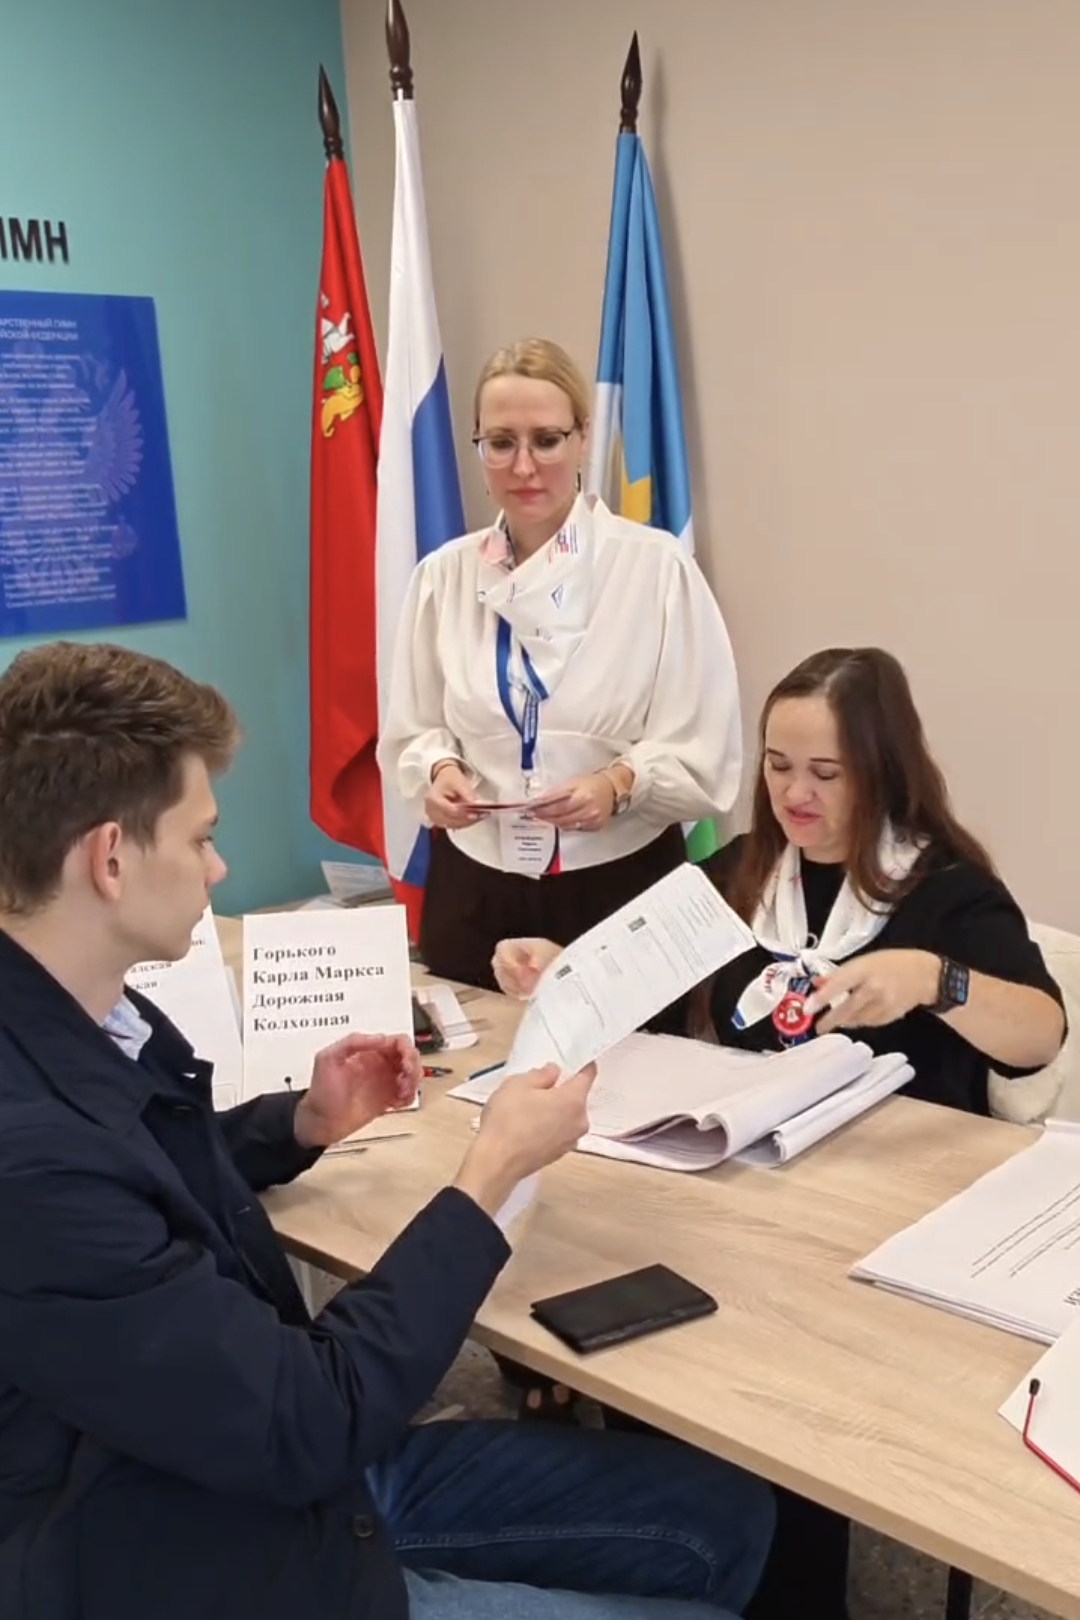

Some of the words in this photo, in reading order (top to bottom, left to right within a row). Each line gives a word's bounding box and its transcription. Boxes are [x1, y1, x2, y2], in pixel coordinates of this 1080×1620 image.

[253, 946, 337, 963] Горького
[253, 970, 309, 986] Карла
[315, 966, 385, 982] Маркса
[252, 991, 345, 1010] Дорожная
[253, 1014, 350, 1032] Колхозная
